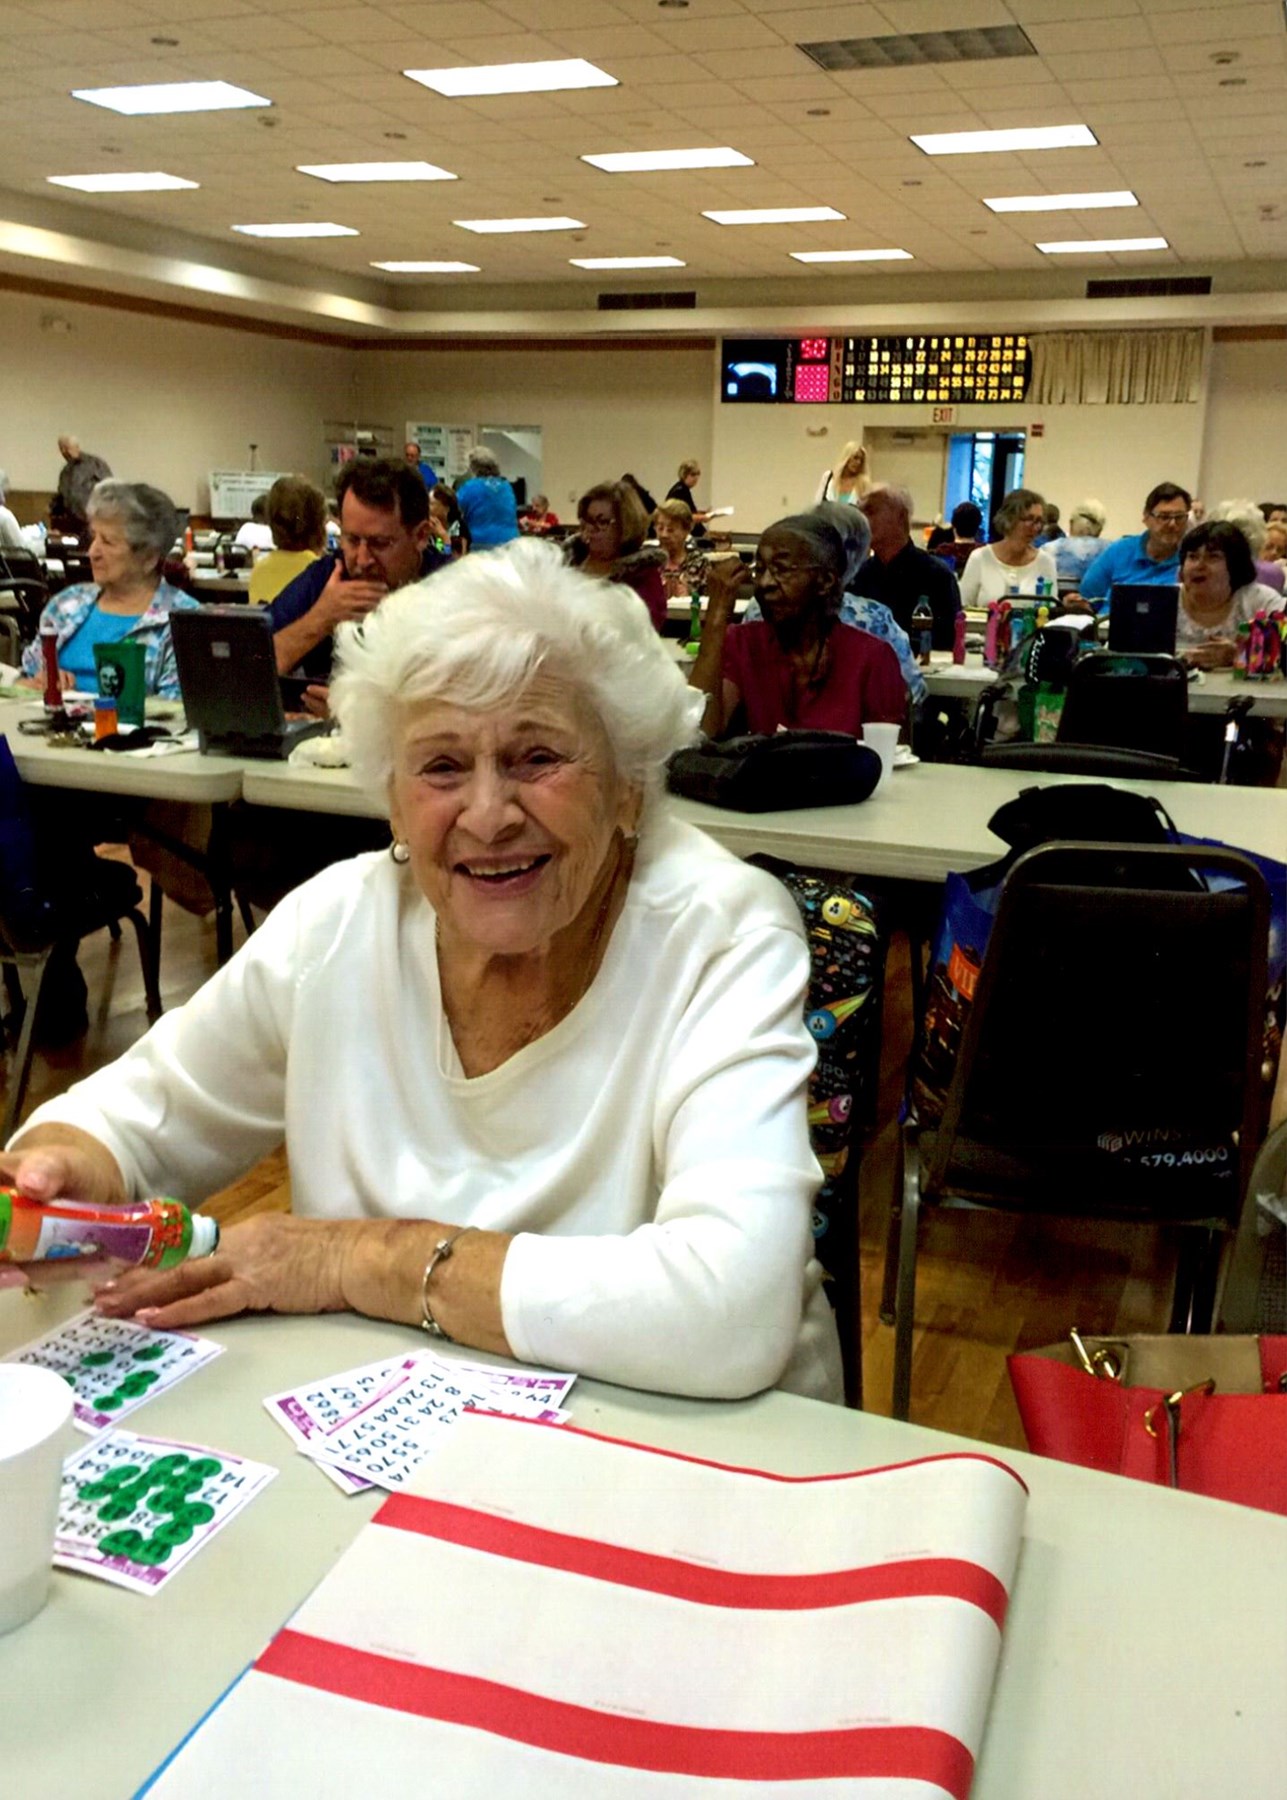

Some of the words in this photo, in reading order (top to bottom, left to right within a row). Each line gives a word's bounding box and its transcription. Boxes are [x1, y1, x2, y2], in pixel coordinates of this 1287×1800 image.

[933, 407, 953, 423] EXIT
[420, 1373, 444, 1389] 13
[396, 1389, 424, 1405] 26
[444, 1386, 461, 1396] 8
[306, 1392, 331, 1409] 62
[418, 1398, 444, 1416] 24
[373, 1405, 399, 1423] 44
[352, 1421, 376, 1440] 57
[396, 1416, 420, 1431] 31
[325, 1439, 352, 1454] 71
[370, 1431, 397, 1448] 50
[345, 1447, 372, 1463] 65
[391, 1440, 419, 1457] 55
[366, 1456, 396, 1473] 70
[220, 1472, 246, 1488] 14
[201, 1487, 229, 1504] 12
